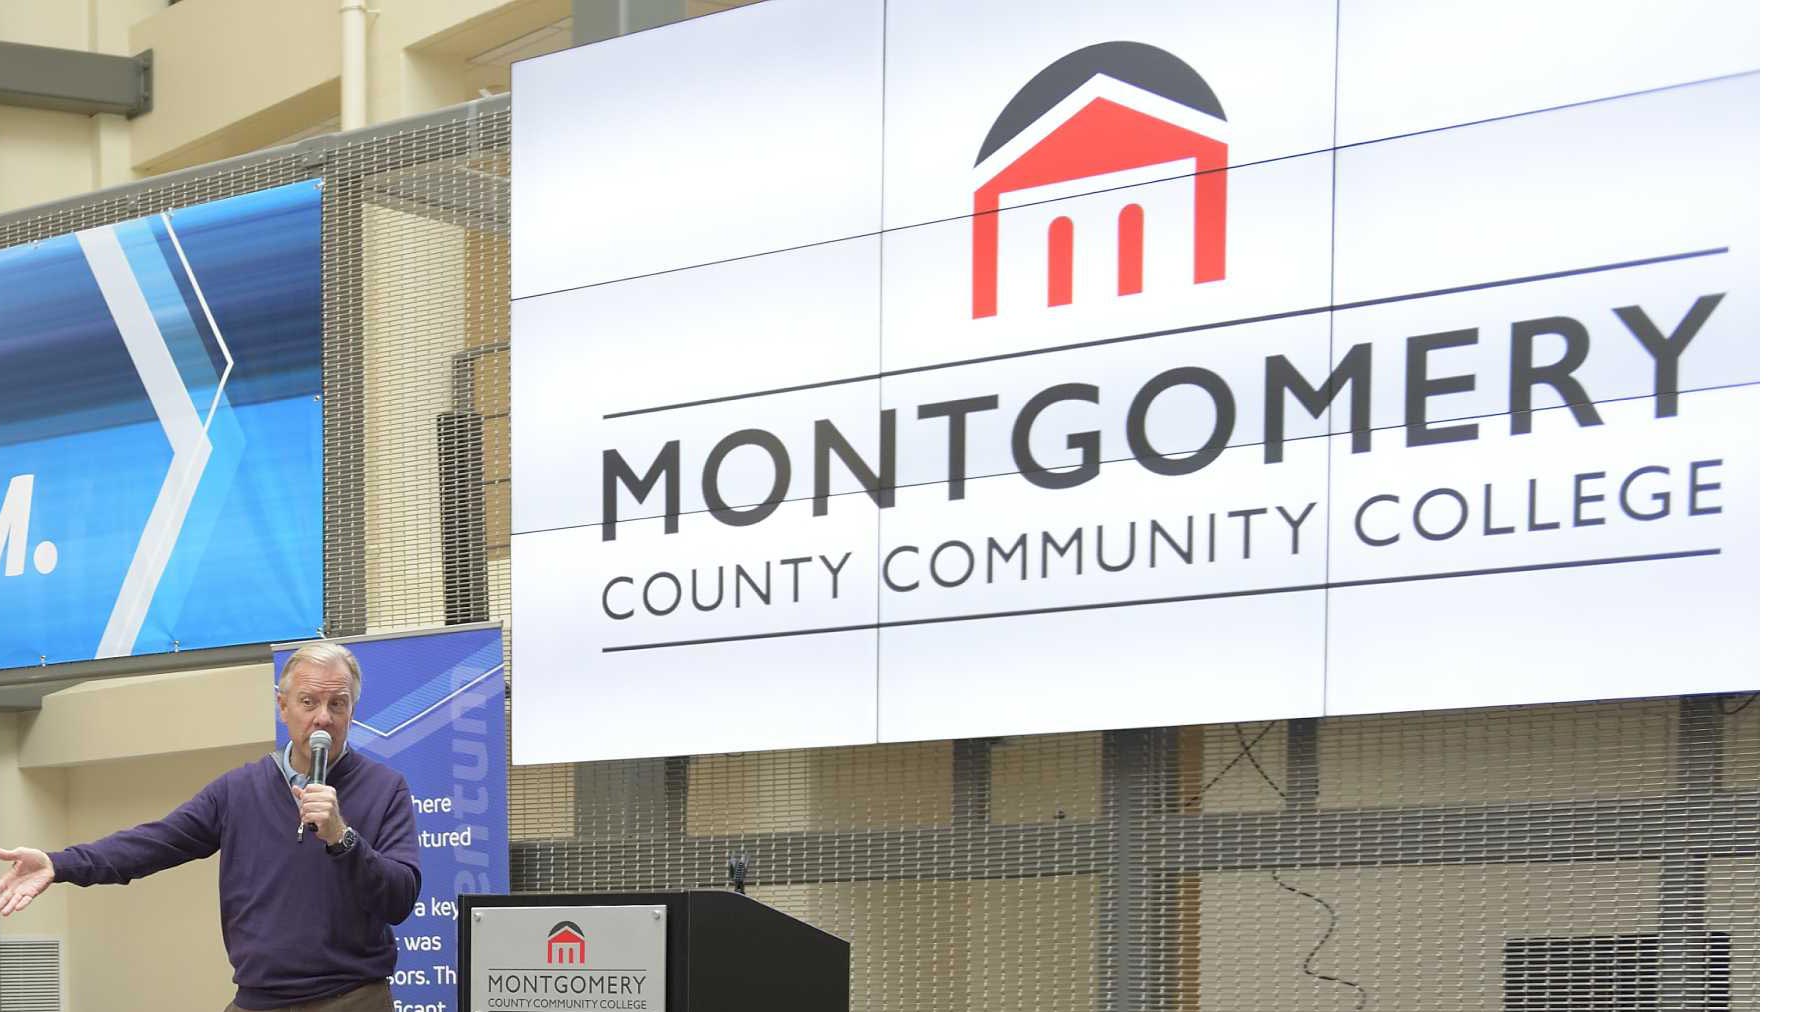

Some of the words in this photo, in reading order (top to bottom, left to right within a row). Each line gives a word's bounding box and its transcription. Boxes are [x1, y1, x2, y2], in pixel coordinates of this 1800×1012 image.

[600, 293, 1726, 542] MONTGOMERY
[602, 552, 851, 620] COUNTY
[883, 502, 1317, 593] COMMUNITY
[1353, 459, 1724, 547] COLLEGE
[414, 902, 426, 917] a
[431, 897, 459, 921] key
[404, 936, 442, 951] was
[487, 974, 647, 995] MONTGOMERY
[487, 998, 533, 1009] COUNTY
[533, 999, 599, 1010] COMMUNITY
[600, 1000, 647, 1011] COLLEGE
